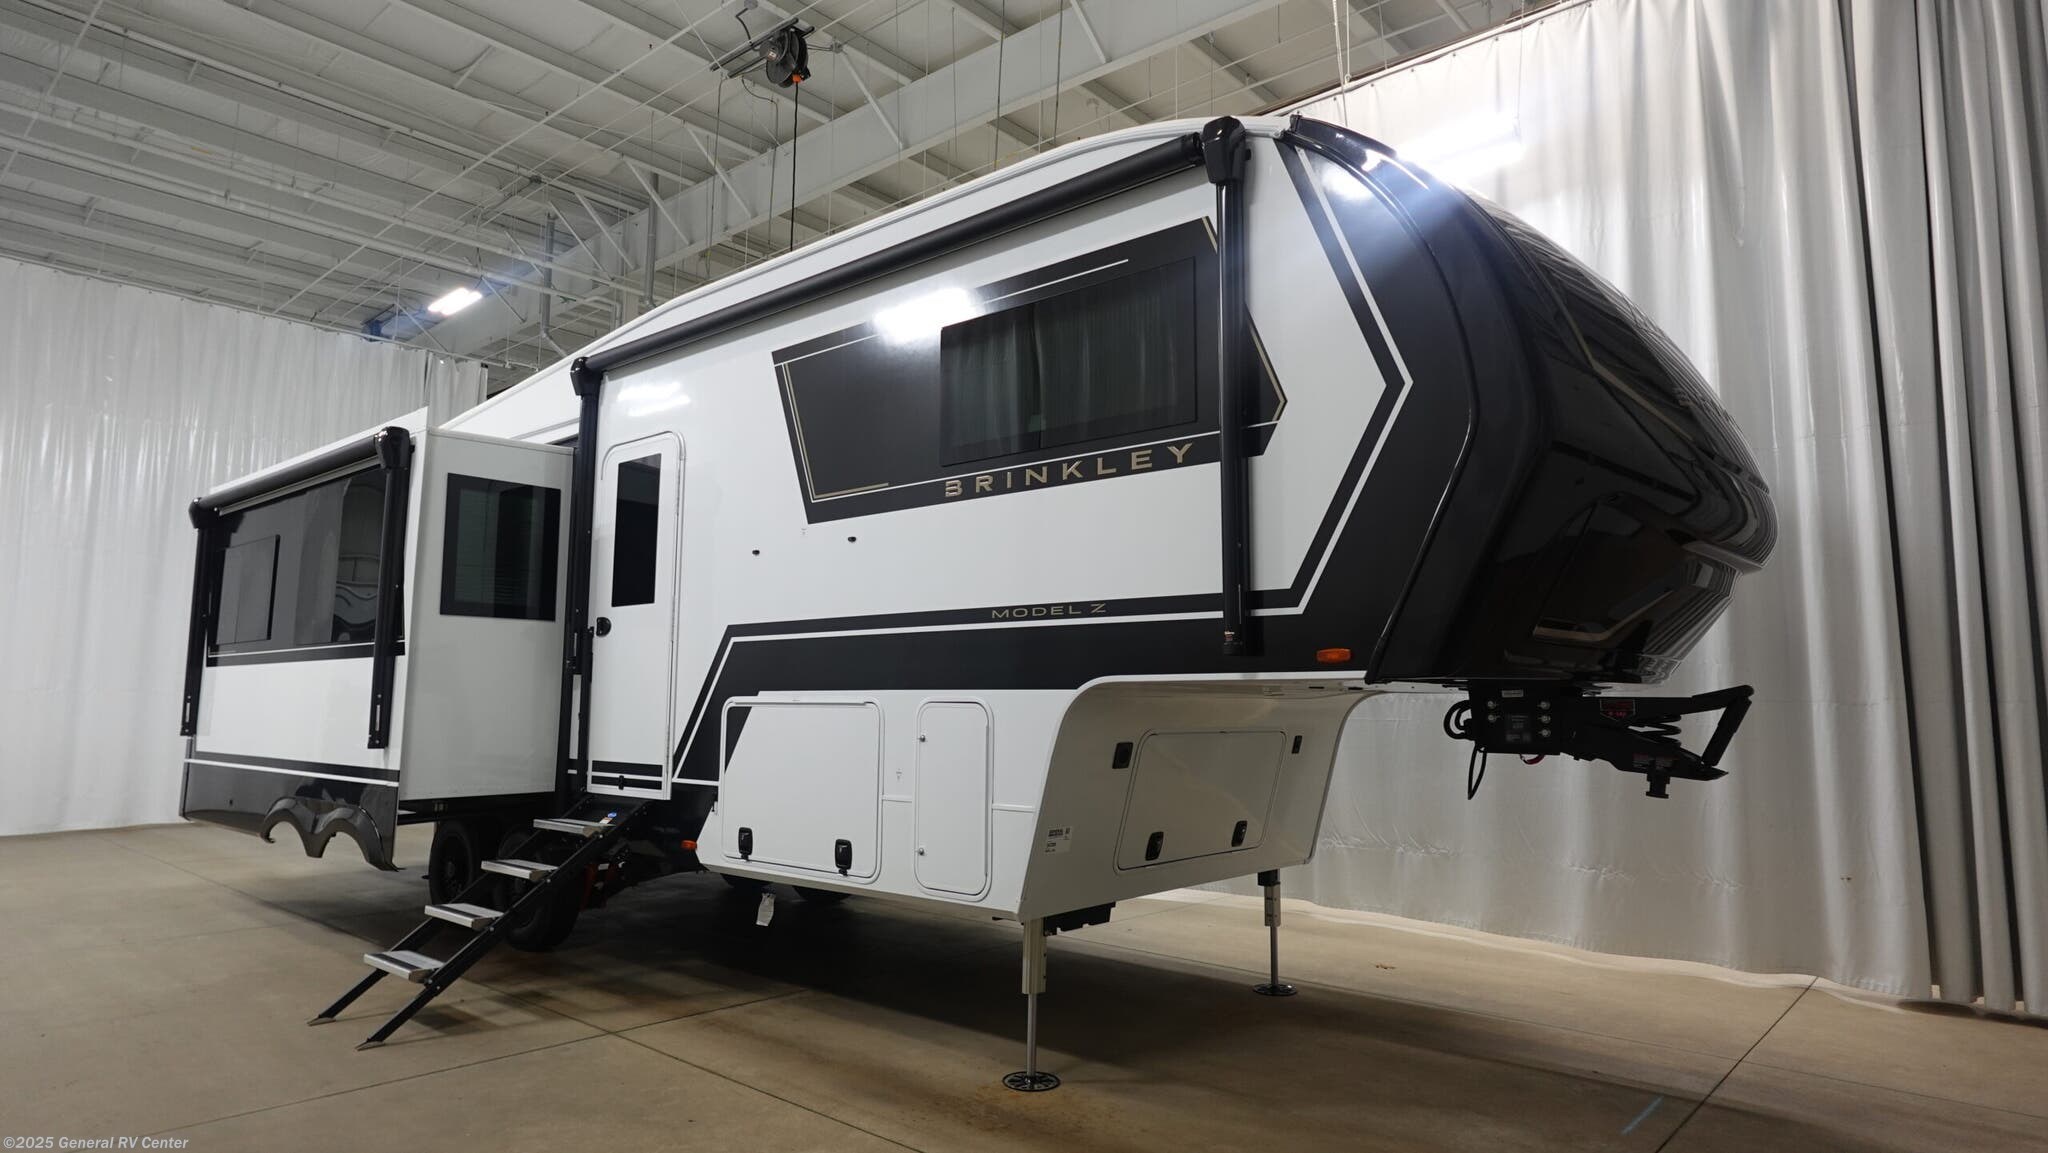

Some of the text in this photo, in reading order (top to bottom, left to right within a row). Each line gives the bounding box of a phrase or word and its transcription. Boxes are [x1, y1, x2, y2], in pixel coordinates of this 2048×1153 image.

[944, 443, 1193, 498] BRINKLEY
[991, 603, 1106, 619] MODEL Z
